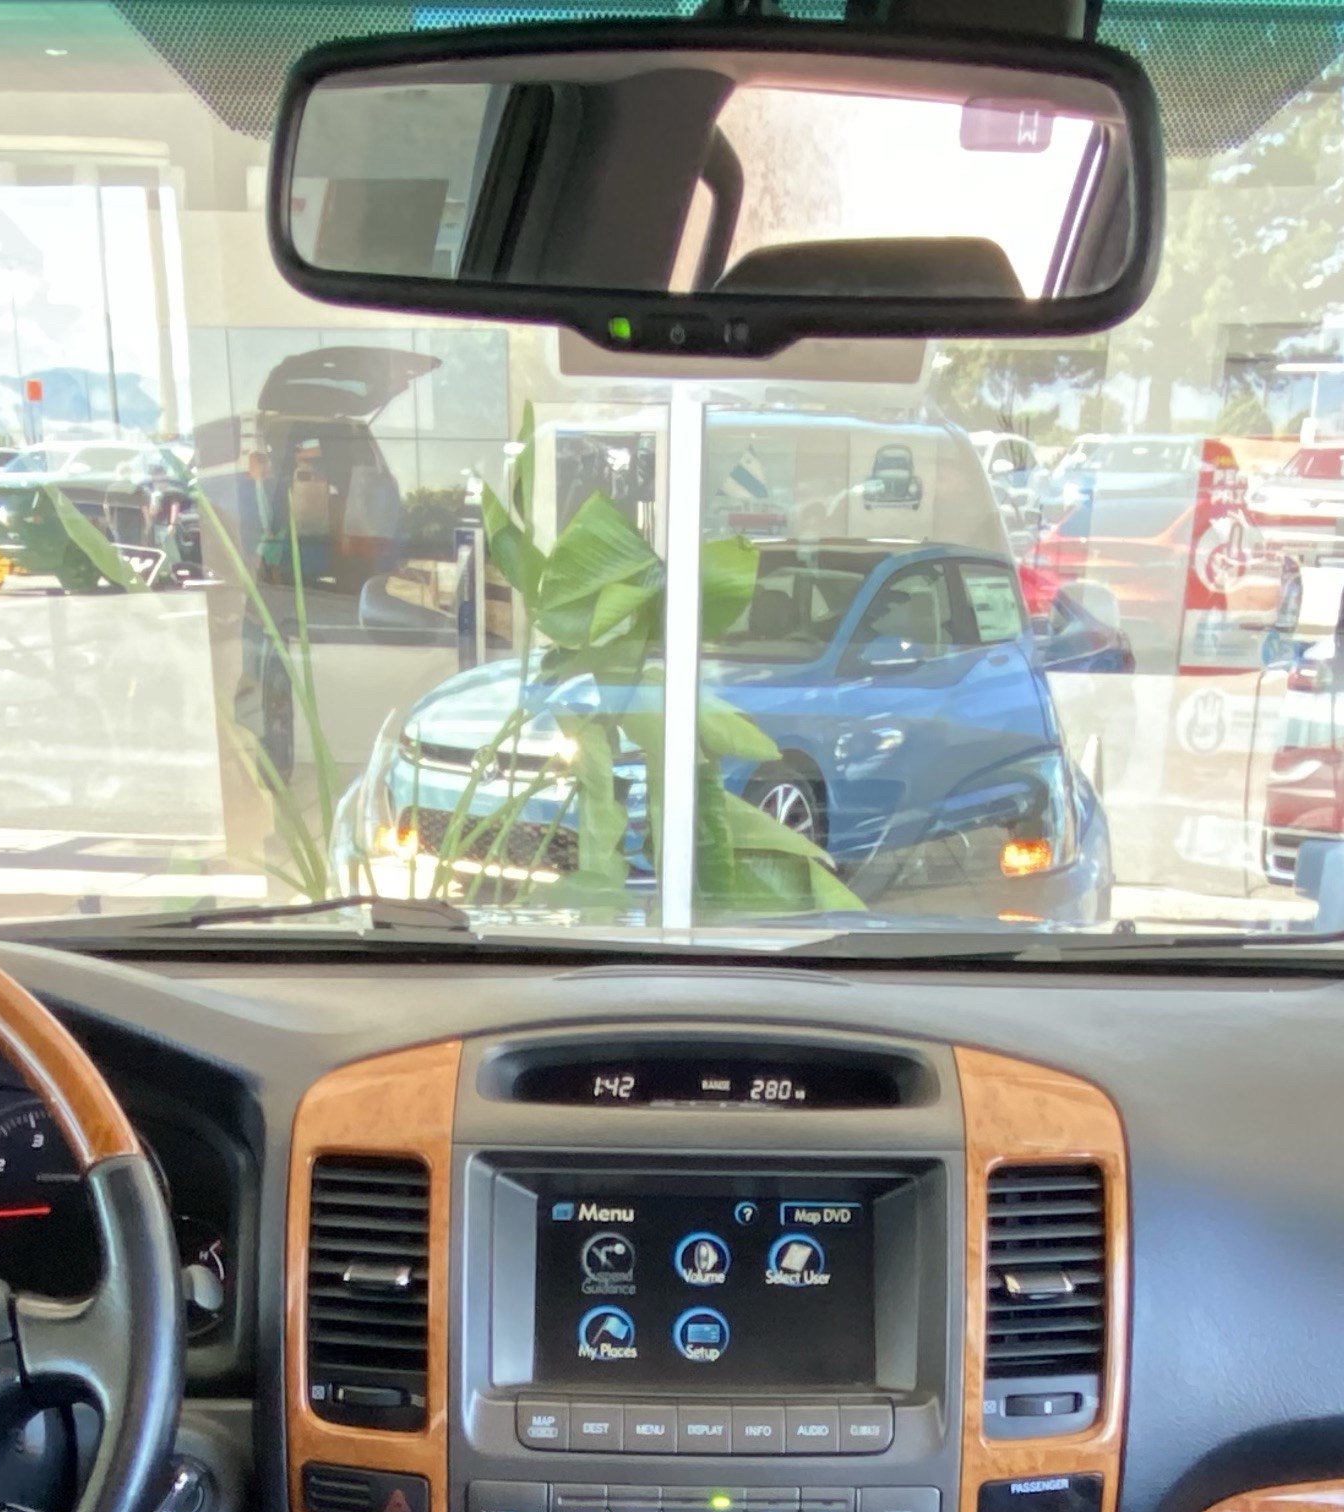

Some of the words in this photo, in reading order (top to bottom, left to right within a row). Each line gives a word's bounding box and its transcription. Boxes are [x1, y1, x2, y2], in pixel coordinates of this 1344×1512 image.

[594, 1076, 635, 1098] 1:42
[701, 1079, 731, 1091] RANGE
[750, 1079, 792, 1100] 280
[31, 1133, 45, 1148] 3
[578, 1203, 635, 1222] Menu
[794, 1209, 821, 1225] Map
[823, 1209, 852, 1223] DVD
[683, 1269, 726, 1284] Volume
[765, 1270, 801, 1285] Select
[803, 1270, 831, 1285] User
[578, 1344, 598, 1360] My
[600, 1343, 637, 1359] Places
[686, 1343, 720, 1361] Setup
[532, 1416, 555, 1426] MAP
[583, 1423, 609, 1434] DEST
[636, 1424, 665, 1435] MENU
[687, 1425, 723, 1436] DISPLAY
[745, 1425, 772, 1437] INFO
[797, 1425, 829, 1437] AUDIO
[1010, 1478, 1069, 1494] PASSENGER
